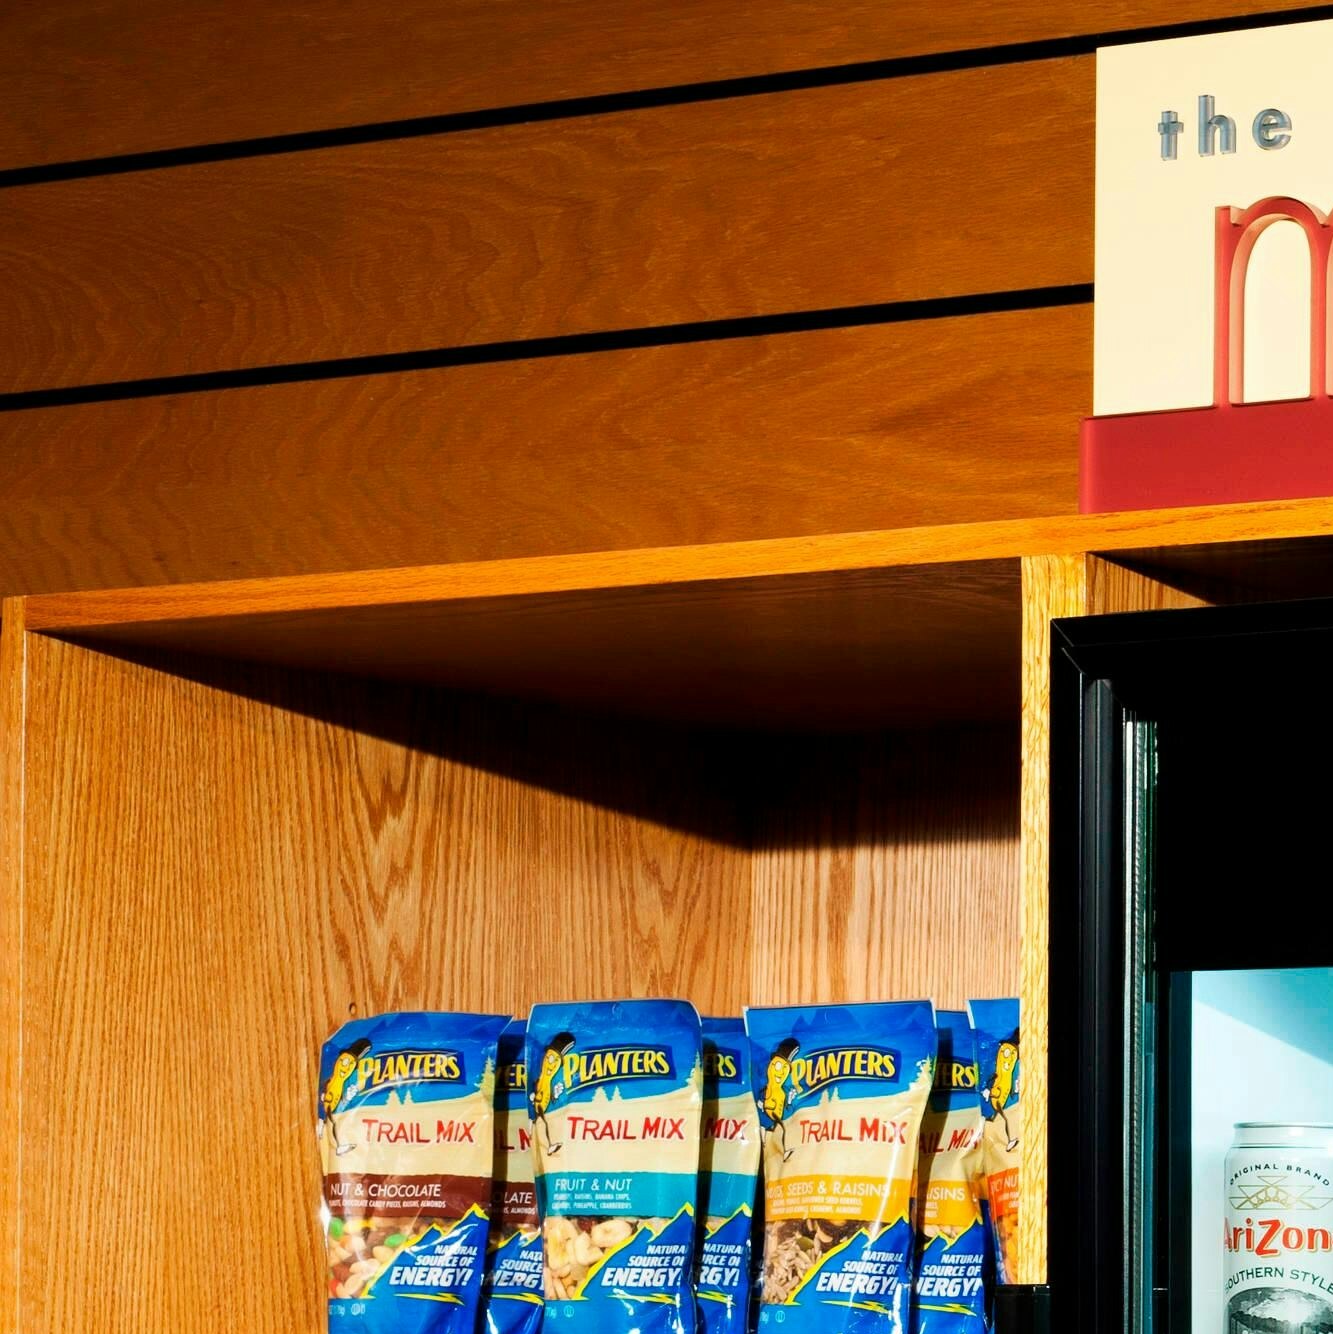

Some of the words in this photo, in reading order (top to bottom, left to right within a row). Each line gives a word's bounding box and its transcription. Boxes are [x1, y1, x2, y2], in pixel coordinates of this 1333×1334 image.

[1156, 93, 1294, 161] the
[355, 1052, 462, 1090] PLANTERS
[562, 1050, 671, 1088] PLANTERS
[792, 1051, 897, 1092] PLANTERS
[362, 1119, 431, 1144] TRAIL
[436, 1120, 478, 1143] MIX
[567, 1116, 637, 1141] TRAIL
[642, 1116, 685, 1140] MIX
[800, 1119, 853, 1144] TRAIL
[859, 1118, 906, 1144] MIX
[555, 1178, 586, 1191] FRUIT
[605, 1178, 632, 1191] NUT
[1287, 1164, 1330, 1186] BRAND
[368, 1184, 441, 1197] CHOCOLATE
[389, 1267, 472, 1287] ENERGY!
